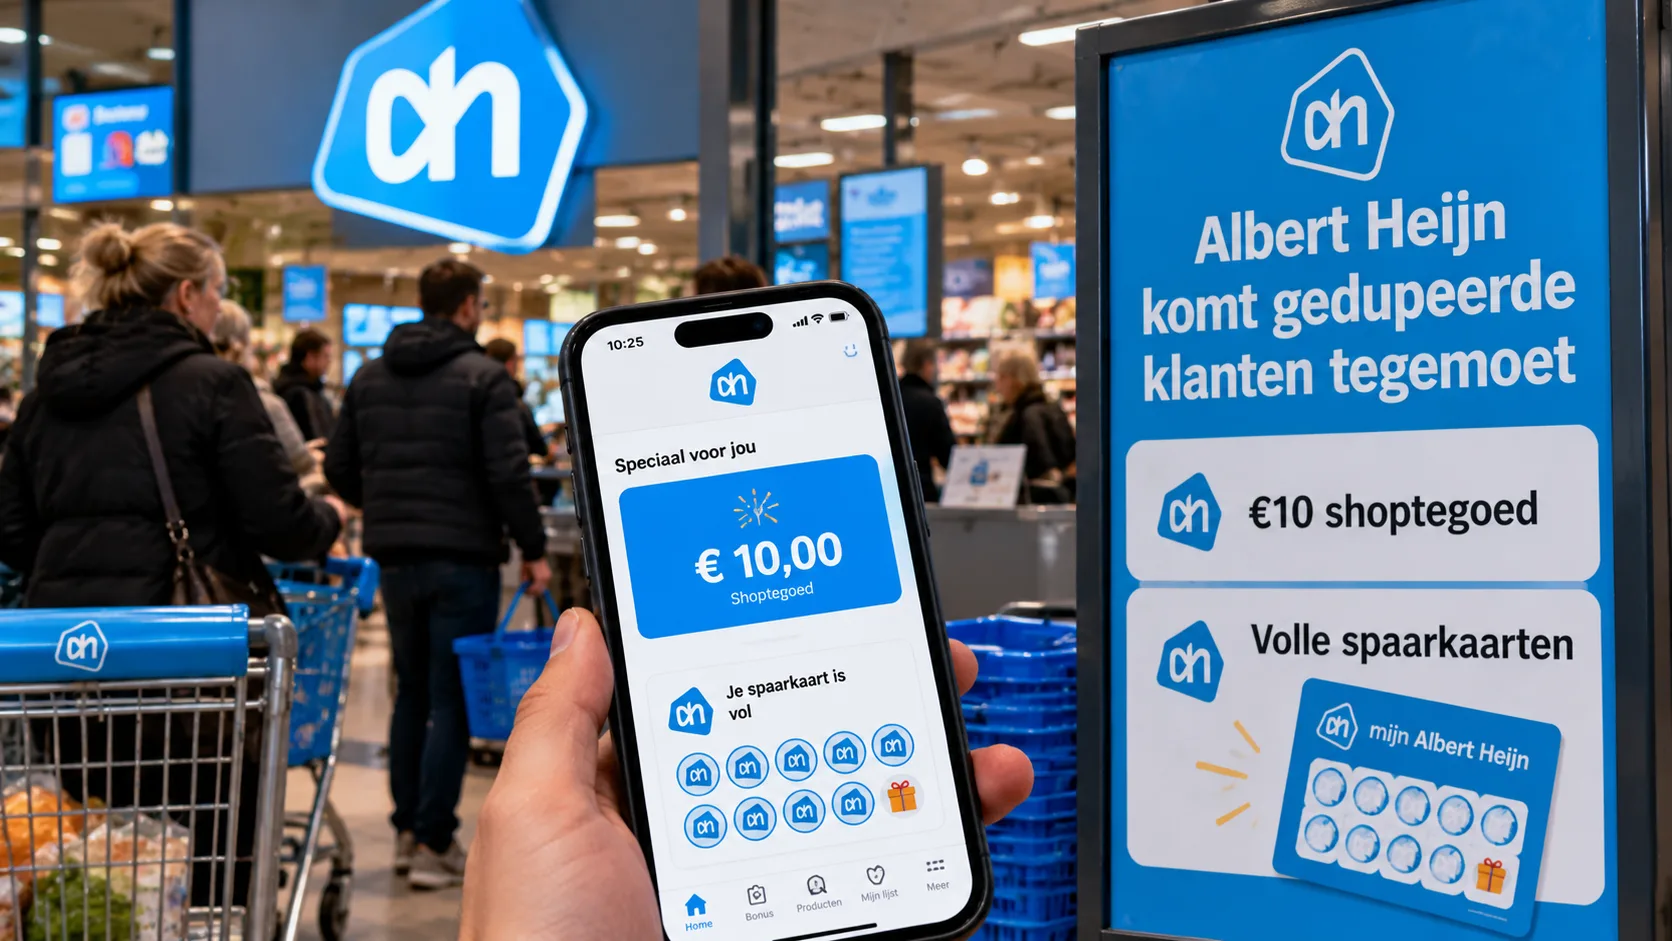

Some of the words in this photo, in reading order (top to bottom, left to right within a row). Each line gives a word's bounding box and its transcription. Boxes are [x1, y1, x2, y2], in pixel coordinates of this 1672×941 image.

[366, 45, 520, 184] ah
[1305, 89, 1368, 151] ah
[1194, 206, 1349, 264] Albert
[1367, 190, 1506, 256] Heijn
[1143, 285, 1258, 335] komt
[1272, 258, 1576, 339] gedupeerde
[607, 336, 644, 351] 10:25
[717, 372, 748, 398] ah
[1144, 353, 1313, 401] klanten
[1329, 336, 1577, 404] tegemoet
[615, 448, 686, 474] Speciaal
[689, 445, 726, 461] voor
[729, 441, 757, 459] jou
[1169, 494, 1209, 533] ah
[1249, 496, 1314, 529] €10
[1325, 489, 1538, 536] shoptegoed
[695, 548, 724, 583] €
[733, 531, 843, 578] 10,00
[731, 582, 814, 605] Shoptegoed
[1251, 623, 1330, 656] Volle
[1342, 625, 1574, 665] spaarkaarten
[1169, 643, 1211, 684] ah
[726, 685, 743, 699] Je
[747, 671, 830, 697] spaarkaart
[832, 669, 846, 682] is
[675, 701, 706, 727] ah
[728, 704, 752, 720] vol
[1370, 723, 1409, 747] mijn
[1414, 731, 1474, 759] Albert
[1480, 742, 1530, 772] Heijn
[861, 891, 882, 904] Mijn
[882, 888, 899, 900] lijst
[926, 880, 950, 892] Meer
[745, 909, 774, 922] Bonus
[796, 898, 842, 913] Producten
[685, 919, 713, 932] Home
